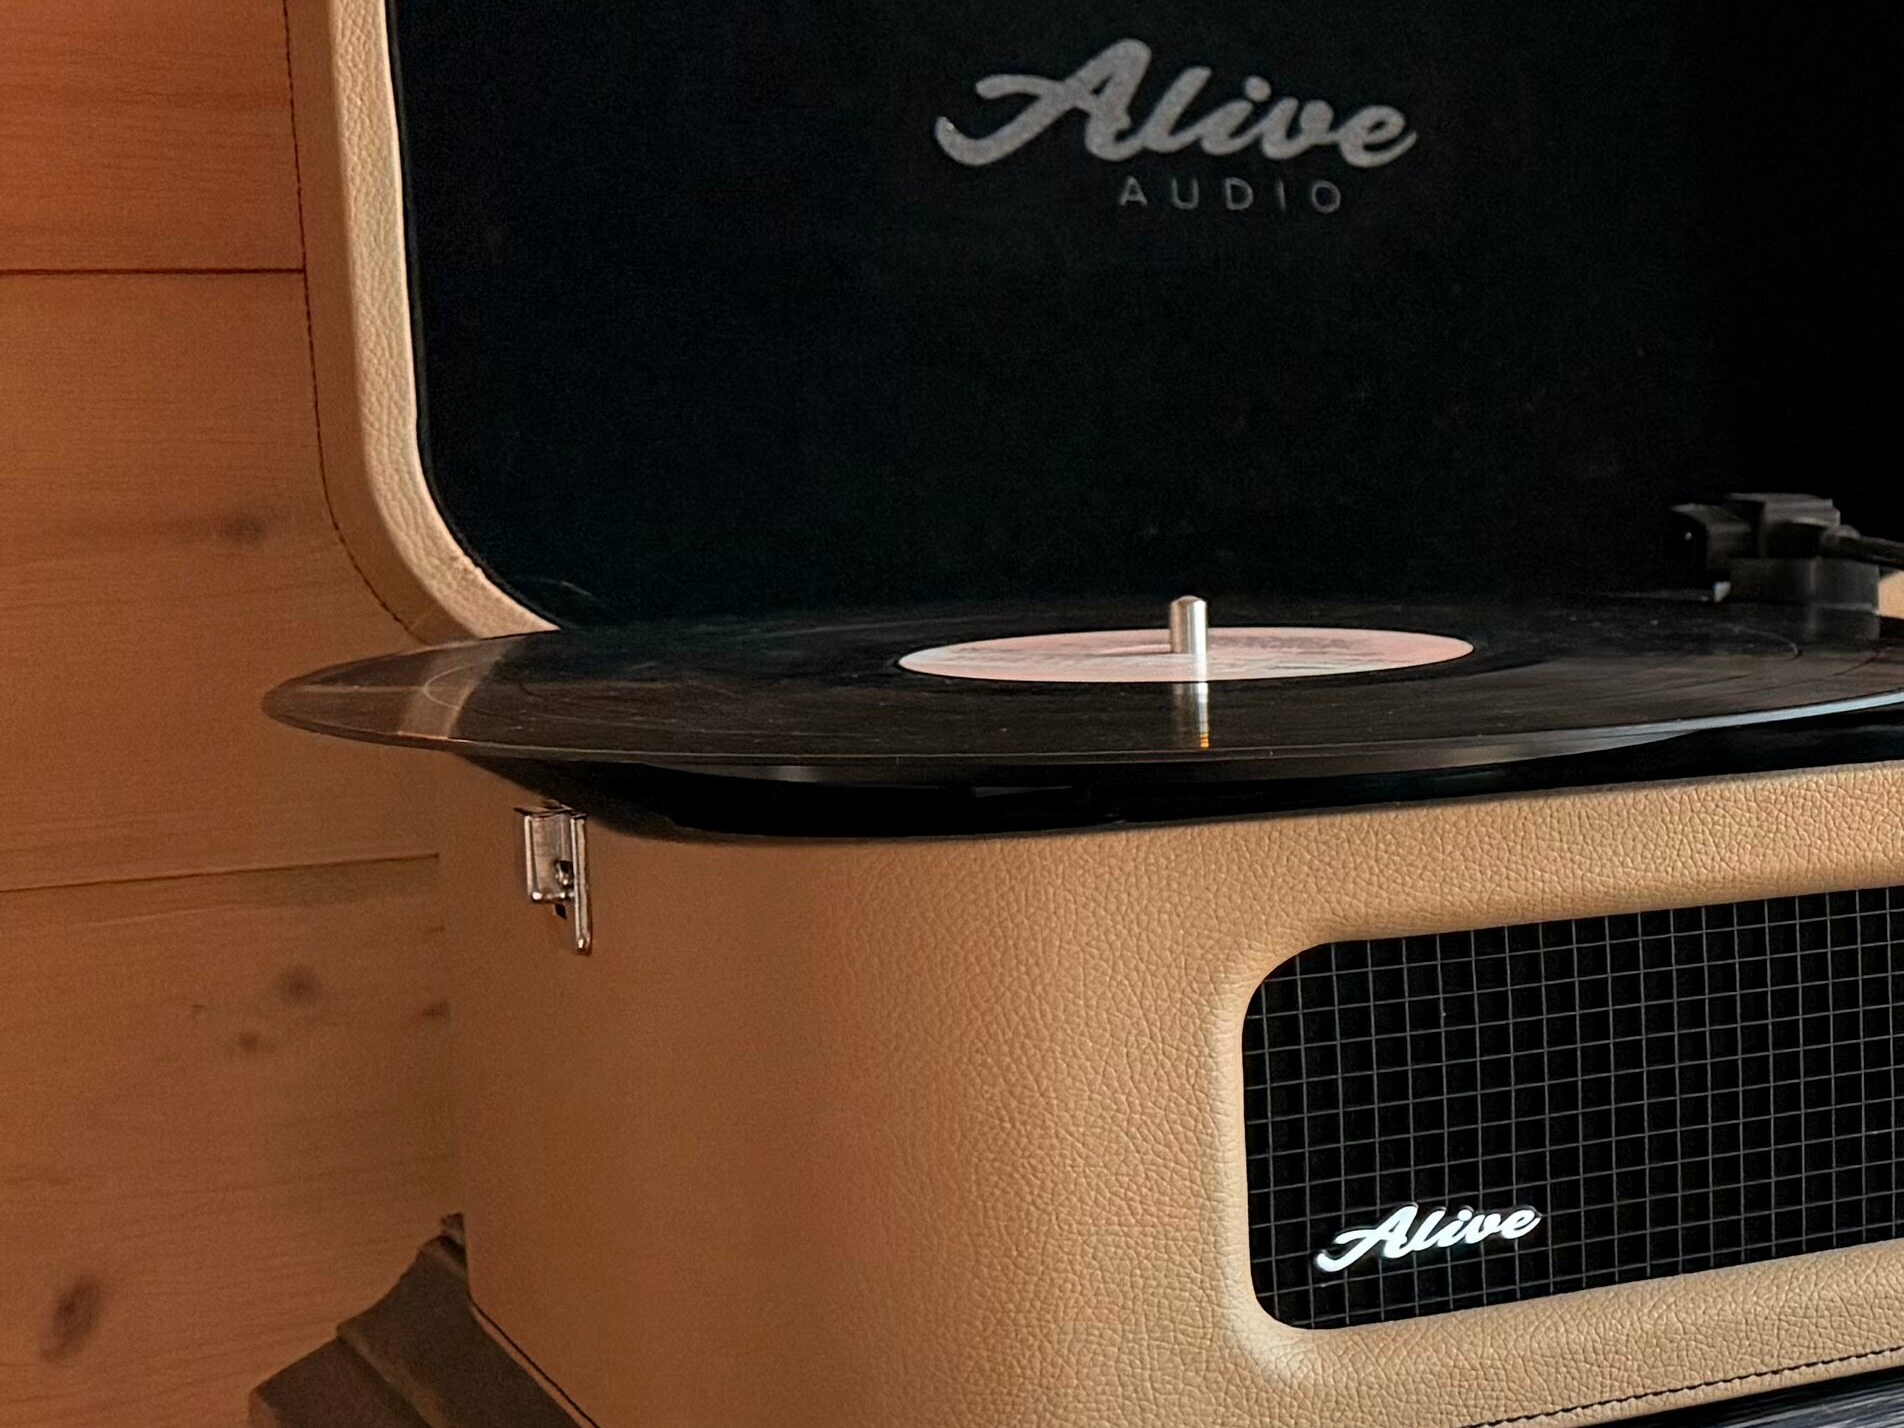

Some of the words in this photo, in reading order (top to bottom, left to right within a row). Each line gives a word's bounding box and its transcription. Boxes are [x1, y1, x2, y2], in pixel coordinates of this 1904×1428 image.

[935, 38, 1418, 166] Alive
[1118, 175, 1343, 213] AUDIO
[1315, 1202, 1543, 1272] Alive
